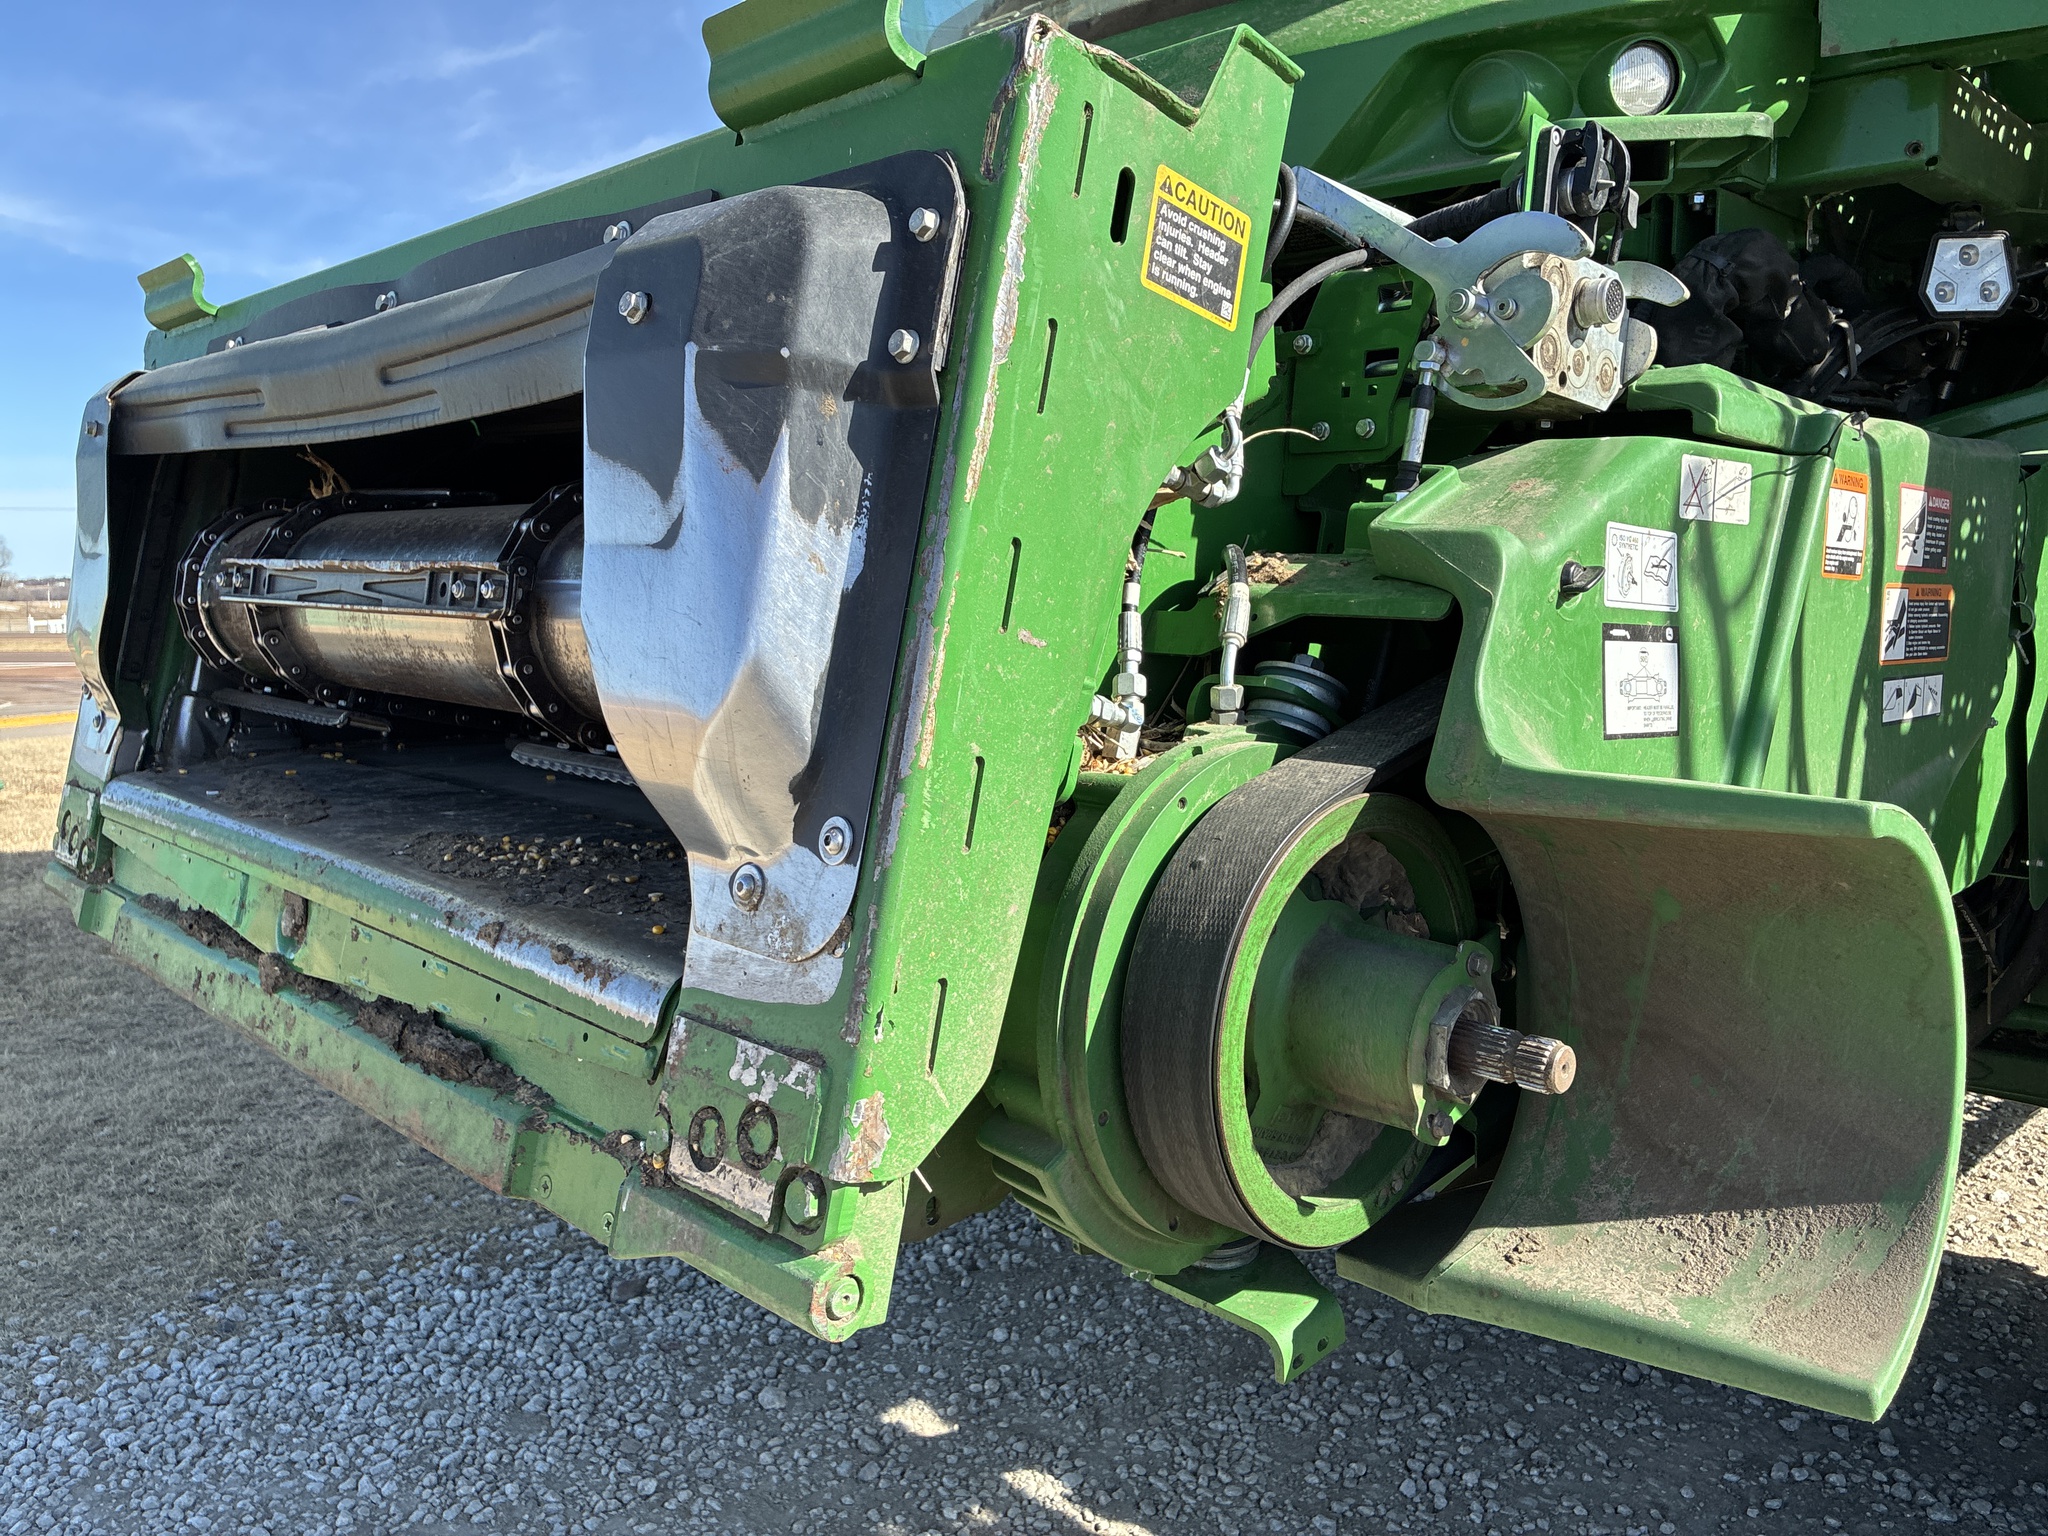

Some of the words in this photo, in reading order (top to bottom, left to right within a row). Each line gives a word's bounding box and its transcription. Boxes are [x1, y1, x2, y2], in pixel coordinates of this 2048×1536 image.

[1160, 203, 1188, 228] Avoid
[1188, 220, 1227, 251] crushing
[1174, 181, 1247, 239] CAUTION
[1155, 236, 1173, 253] can
[1173, 242, 1189, 261] tilt.
[1192, 254, 1213, 274] Stay
[1157, 218, 1193, 248] injuries.
[1197, 240, 1229, 267] Header
[1151, 262, 1161, 277] is
[1161, 271, 1199, 299] running.
[1153, 249, 1176, 269] clear
[1178, 264, 1202, 284] when
[1202, 276, 1232, 299] engine
[1839, 474, 1864, 489] WARNING
[1932, 496, 1950, 510] DANGER
[1921, 587, 1942, 597] WARNING
